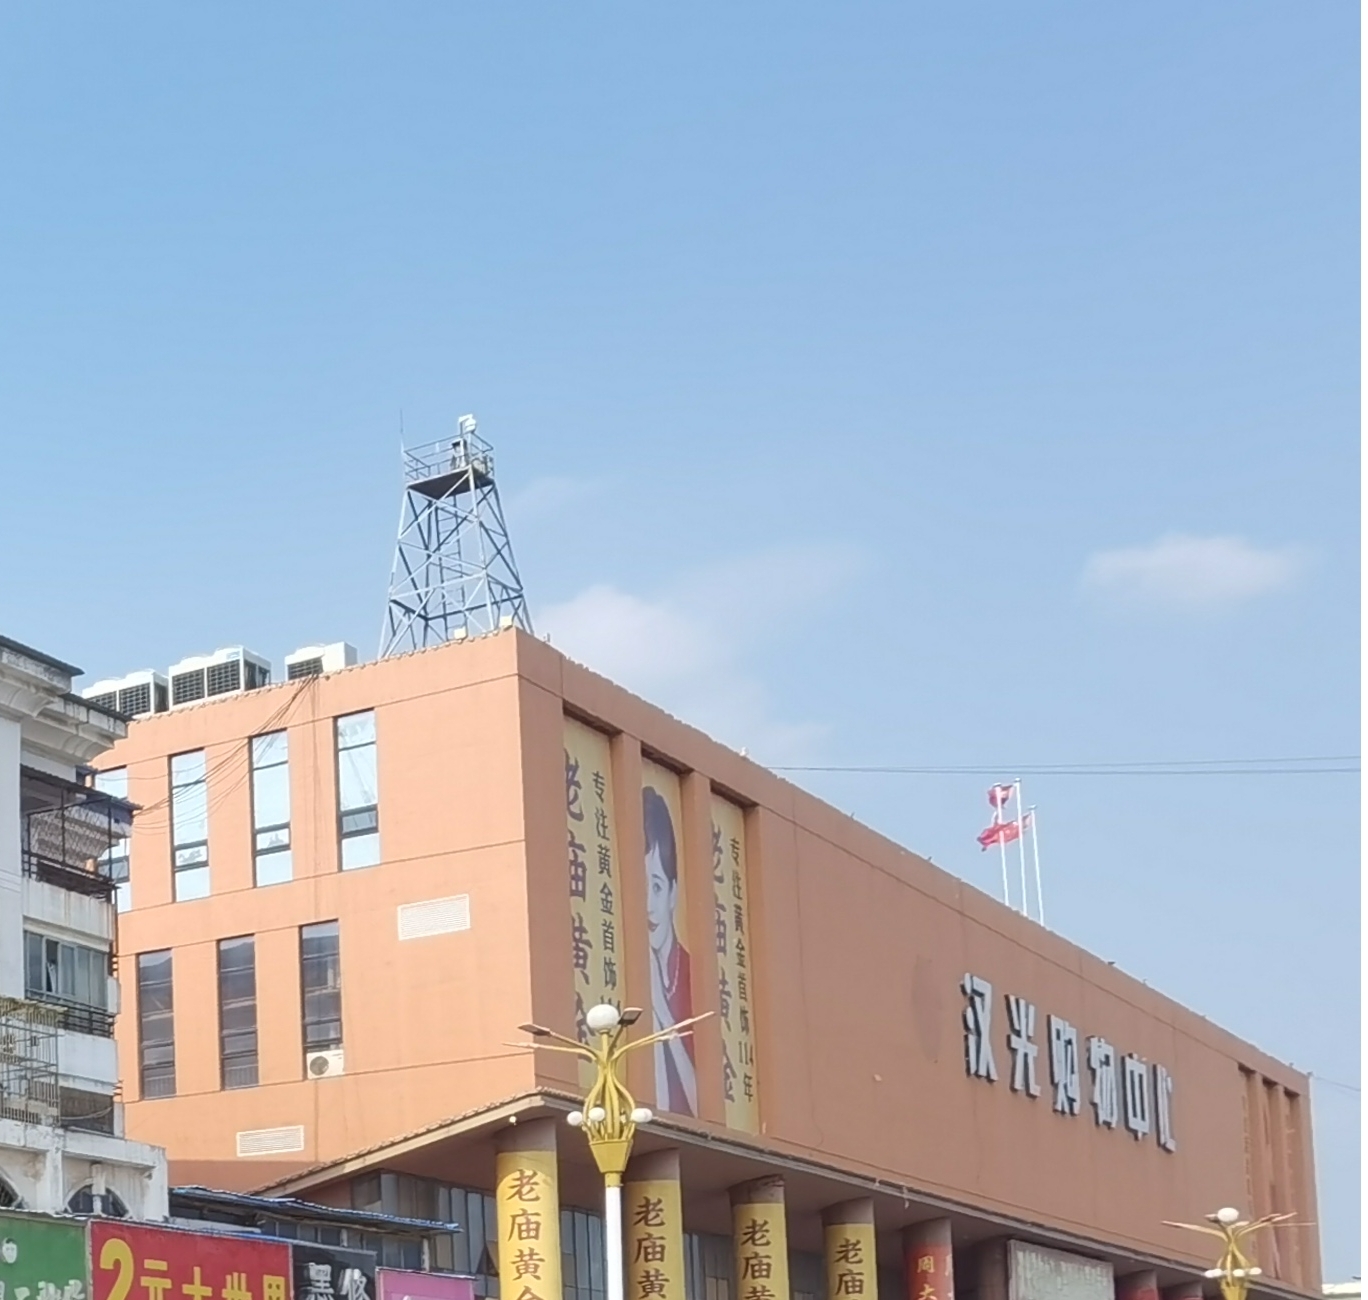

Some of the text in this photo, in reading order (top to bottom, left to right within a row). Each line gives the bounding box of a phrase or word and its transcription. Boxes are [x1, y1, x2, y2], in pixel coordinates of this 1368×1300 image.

[960, 972, 1176, 1153] 汉光购物中心
